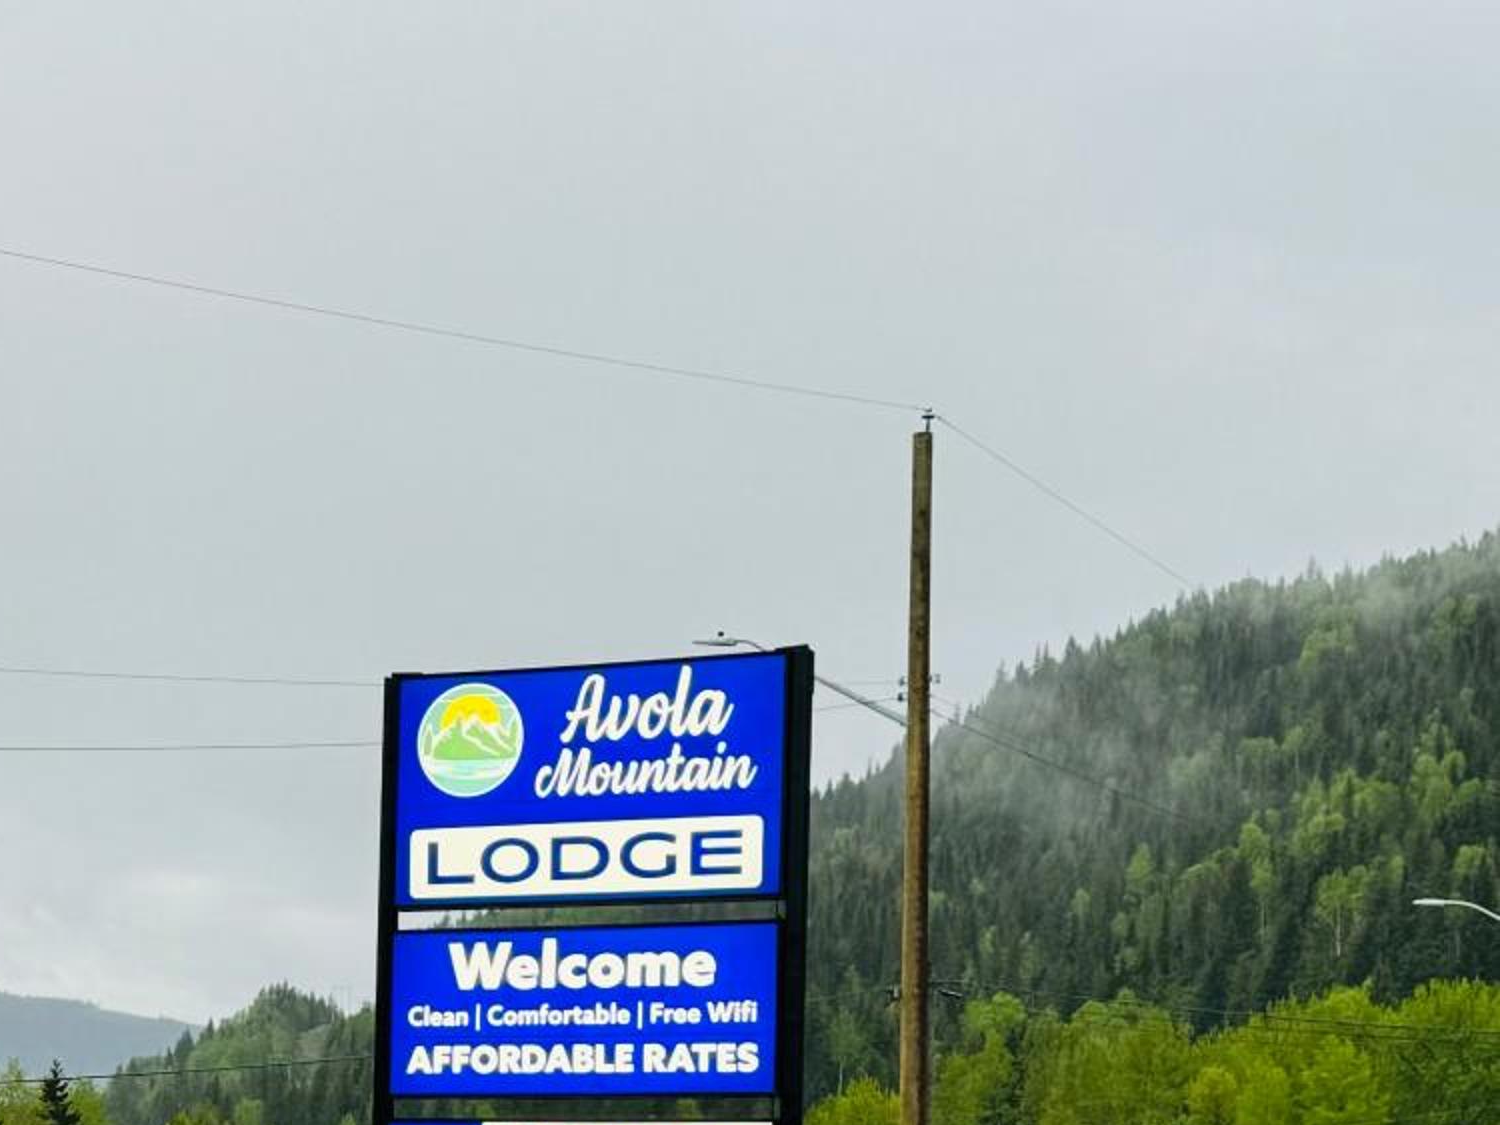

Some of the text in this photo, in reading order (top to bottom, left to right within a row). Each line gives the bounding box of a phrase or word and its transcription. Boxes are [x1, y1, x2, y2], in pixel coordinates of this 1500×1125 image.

[559, 664, 735, 743] Avola
[534, 742, 758, 799] Mountain
[426, 828, 743, 886] LODGE
[448, 937, 717, 991] Welcome
[407, 1004, 469, 1028] Clean
[486, 1001, 631, 1027] Comfortable
[649, 1001, 702, 1025] Free
[706, 999, 758, 1024] Wifi
[406, 1041, 760, 1075] AFFORDABLE RATES
